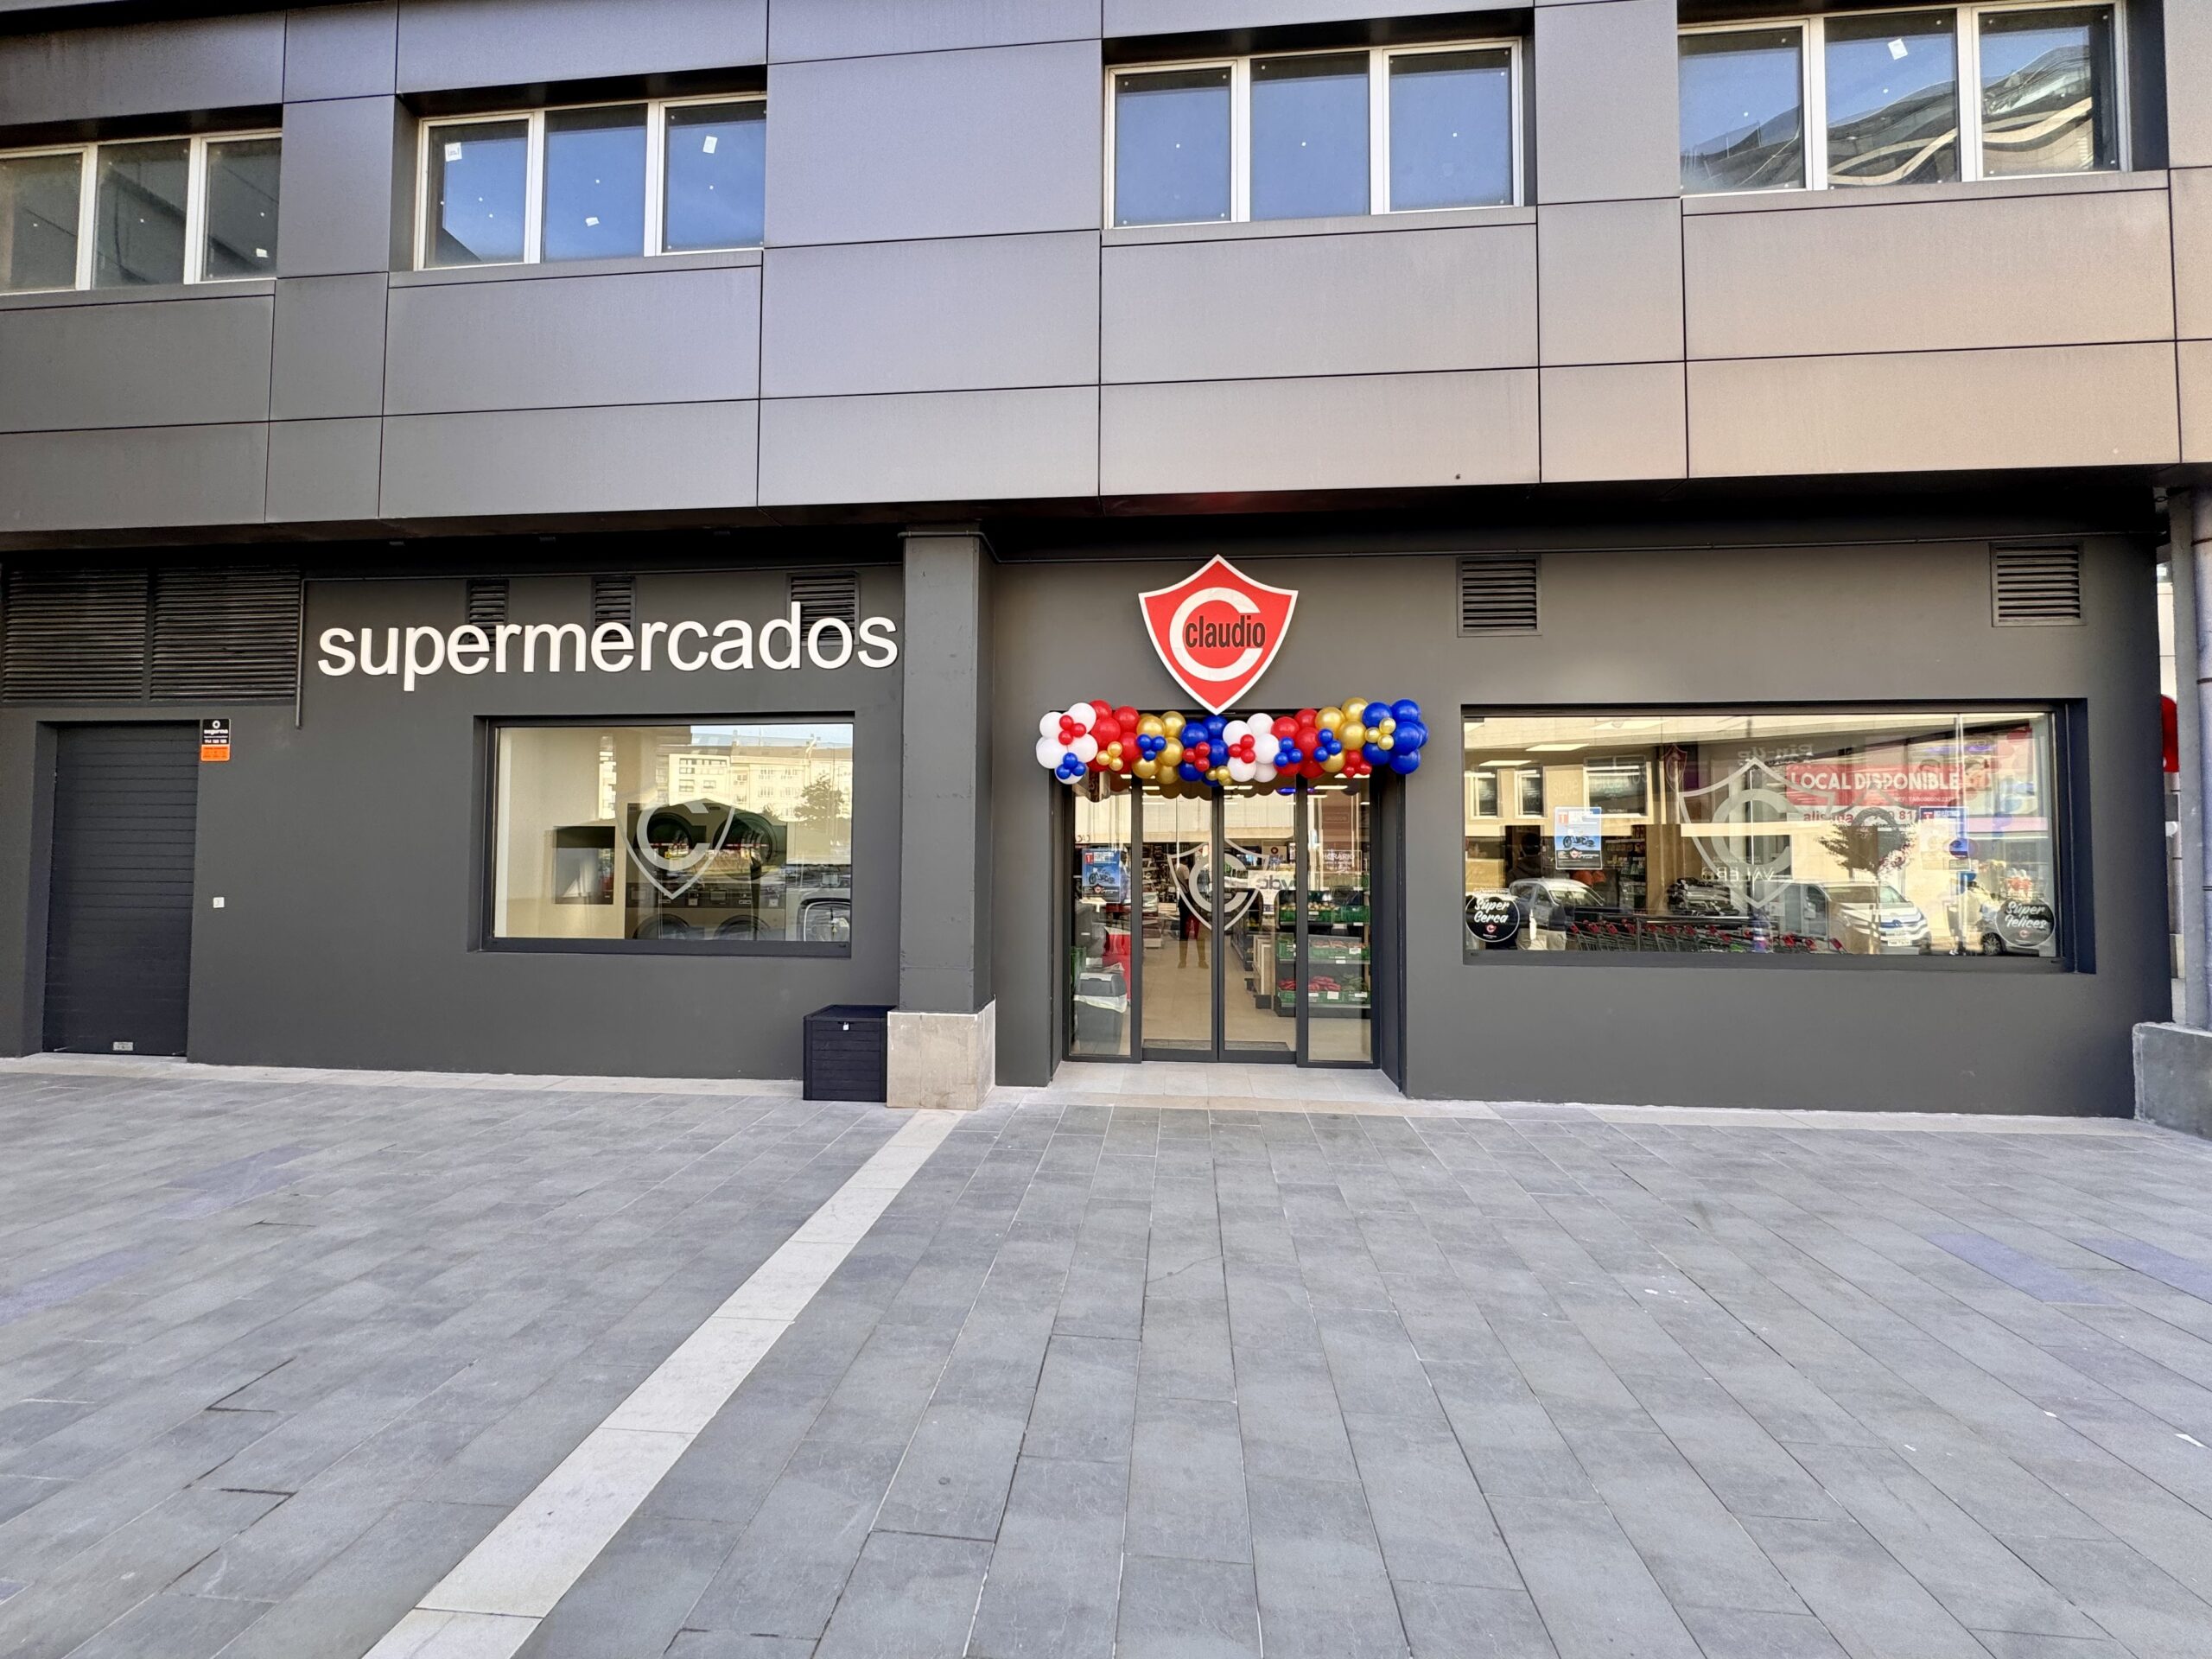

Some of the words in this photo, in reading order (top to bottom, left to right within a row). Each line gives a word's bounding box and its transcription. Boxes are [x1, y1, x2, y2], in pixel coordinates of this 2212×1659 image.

[1185, 615, 1266, 648] claudio
[317, 601, 899, 691] supermercados
[1791, 772, 1851, 790] LOCAL
[1855, 772, 1959, 790] DISPONIBLE
[1474, 899, 1510, 914] Súper
[2005, 901, 2046, 918] Súper
[1474, 910, 1509, 924] Cerca
[2005, 914, 2048, 928] Felices
